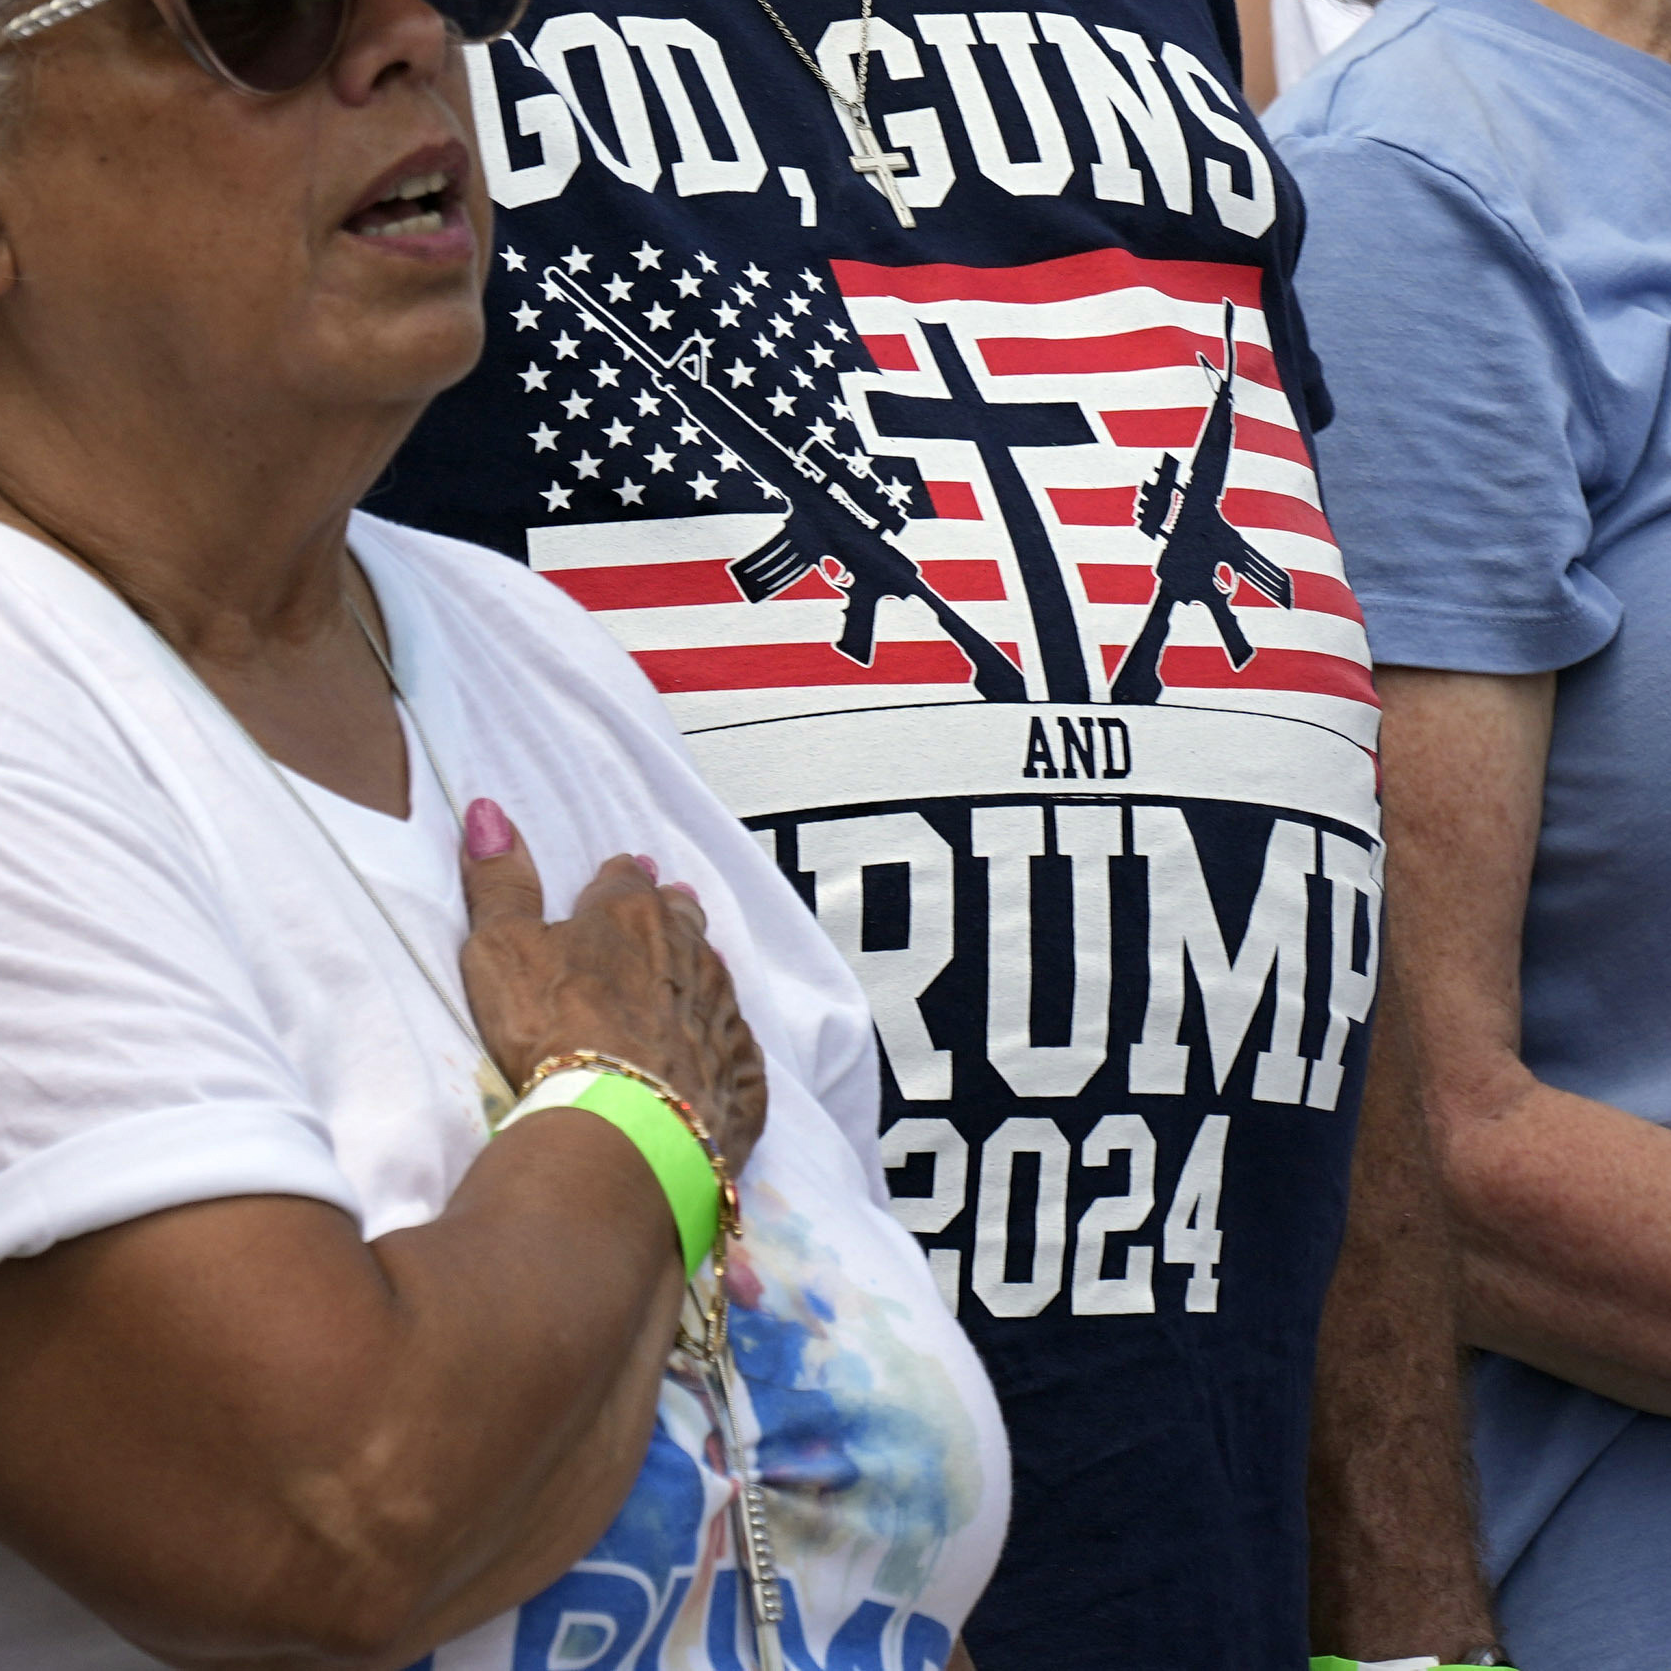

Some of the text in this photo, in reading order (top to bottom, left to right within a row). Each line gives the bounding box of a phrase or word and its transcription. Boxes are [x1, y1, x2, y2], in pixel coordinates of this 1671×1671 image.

[462, 11, 1275, 239] GOD, GUNS
[1022, 715, 1132, 779] AND
[748, 805, 1384, 1112] RUMP
[879, 1114, 1230, 1318] 2024
